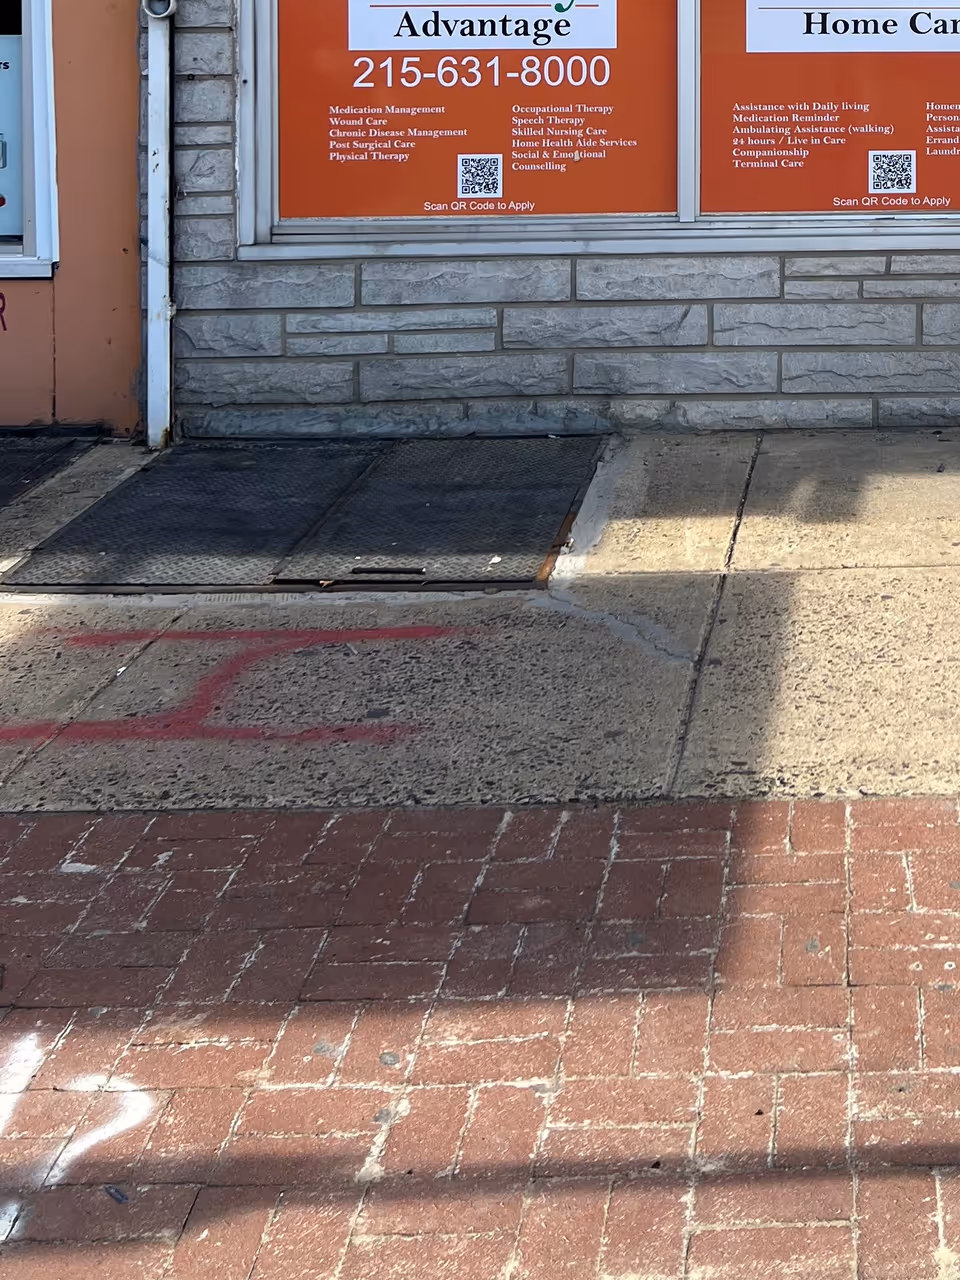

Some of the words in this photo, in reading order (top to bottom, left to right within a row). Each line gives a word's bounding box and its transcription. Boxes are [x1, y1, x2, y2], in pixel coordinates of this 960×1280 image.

[802, 11, 898, 35] Home
[393, 11, 571, 46] Advantage
[353, 55, 610, 87] 215-631-8000
[329, 106, 382, 114] Medication
[385, 106, 445, 115] Management
[512, 105, 573, 114] Occupational
[576, 104, 613, 114] Therapy
[733, 102, 785, 111] Assistance
[788, 102, 809, 110] with
[812, 102, 838, 112] Daily
[842, 102, 869, 113] living
[512, 116, 544, 126] Speech
[547, 116, 585, 126] Therapy
[733, 114, 789, 122] Medication
[329, 129, 366, 137] Chronic
[408, 128, 467, 138] Management
[512, 128, 543, 136] Skilled
[547, 127, 583, 137] Nursing
[586, 127, 607, 135] Care
[733, 125, 791, 135] Ambulating
[794, 125, 845, 133] Assistance
[848, 124, 894, 134] (walking)
[353, 141, 391, 150] Surgical
[394, 140, 416, 148] Care
[512, 139, 539, 147] Home
[542, 139, 573, 147] Health
[576, 138, 597, 146] Aide
[600, 138, 637, 146] Services
[733, 137, 745, 145] 24
[748, 137, 776, 145] hours
[778, 137, 784, 145] /
[787, 136, 808, 144] Live
[811, 136, 820, 144] in
[823, 136, 846, 144] Care
[926, 136, 959, 144] Errand
[329, 152, 368, 162] Physical
[370, 152, 409, 161] Therapy
[512, 150, 539, 159] Social
[733, 148, 809, 158] Companionship
[512, 162, 566, 172] Counselling
[733, 160, 778, 168] Terminal
[781, 159, 804, 167] Care
[424, 202, 448, 210] Scan
[451, 202, 466, 210] QR
[469, 201, 494, 210] Code
[509, 200, 535, 211] Apply
[833, 197, 858, 206] Scan
[862, 197, 878, 206] QR
[881, 197, 908, 205] Code
[911, 197, 920, 205] to
[923, 196, 950, 206] Apply
